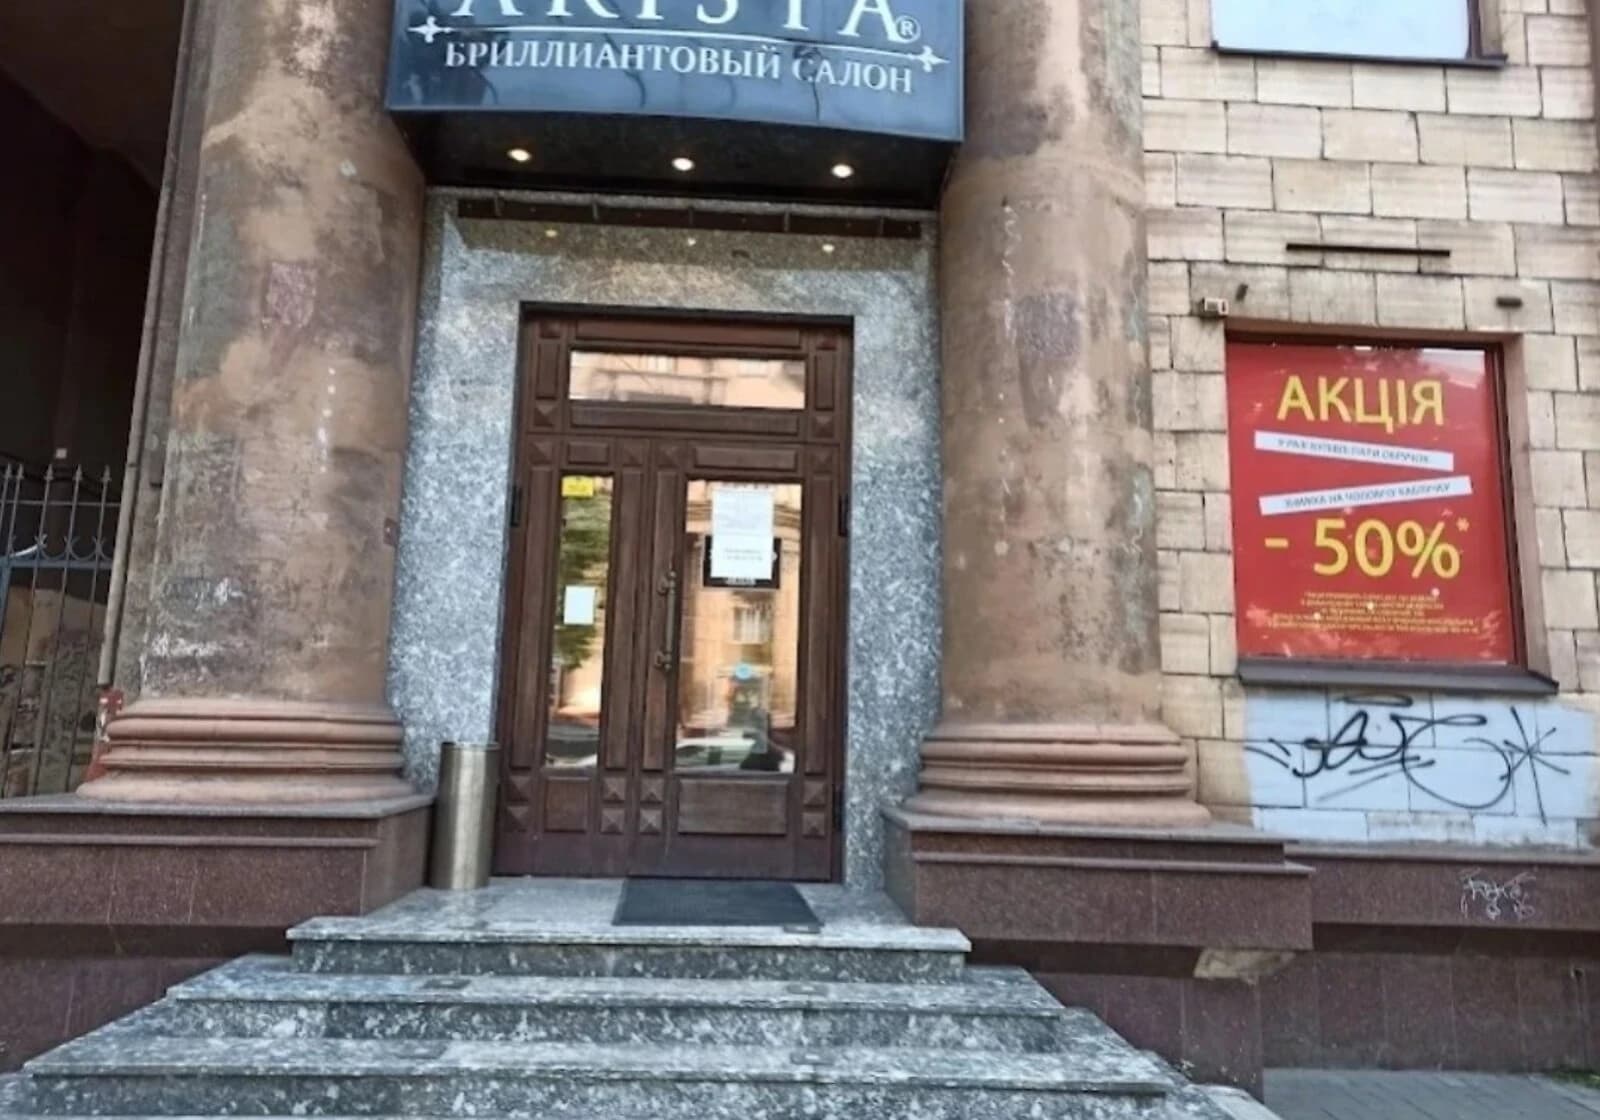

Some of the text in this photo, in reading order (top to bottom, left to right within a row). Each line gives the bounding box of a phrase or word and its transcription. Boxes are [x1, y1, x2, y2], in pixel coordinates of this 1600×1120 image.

[446, 40, 912, 93] БРИЛЛИАНТОВЫЙ САЛОН
[1277, 376, 1444, 433] АКЦІЯ
